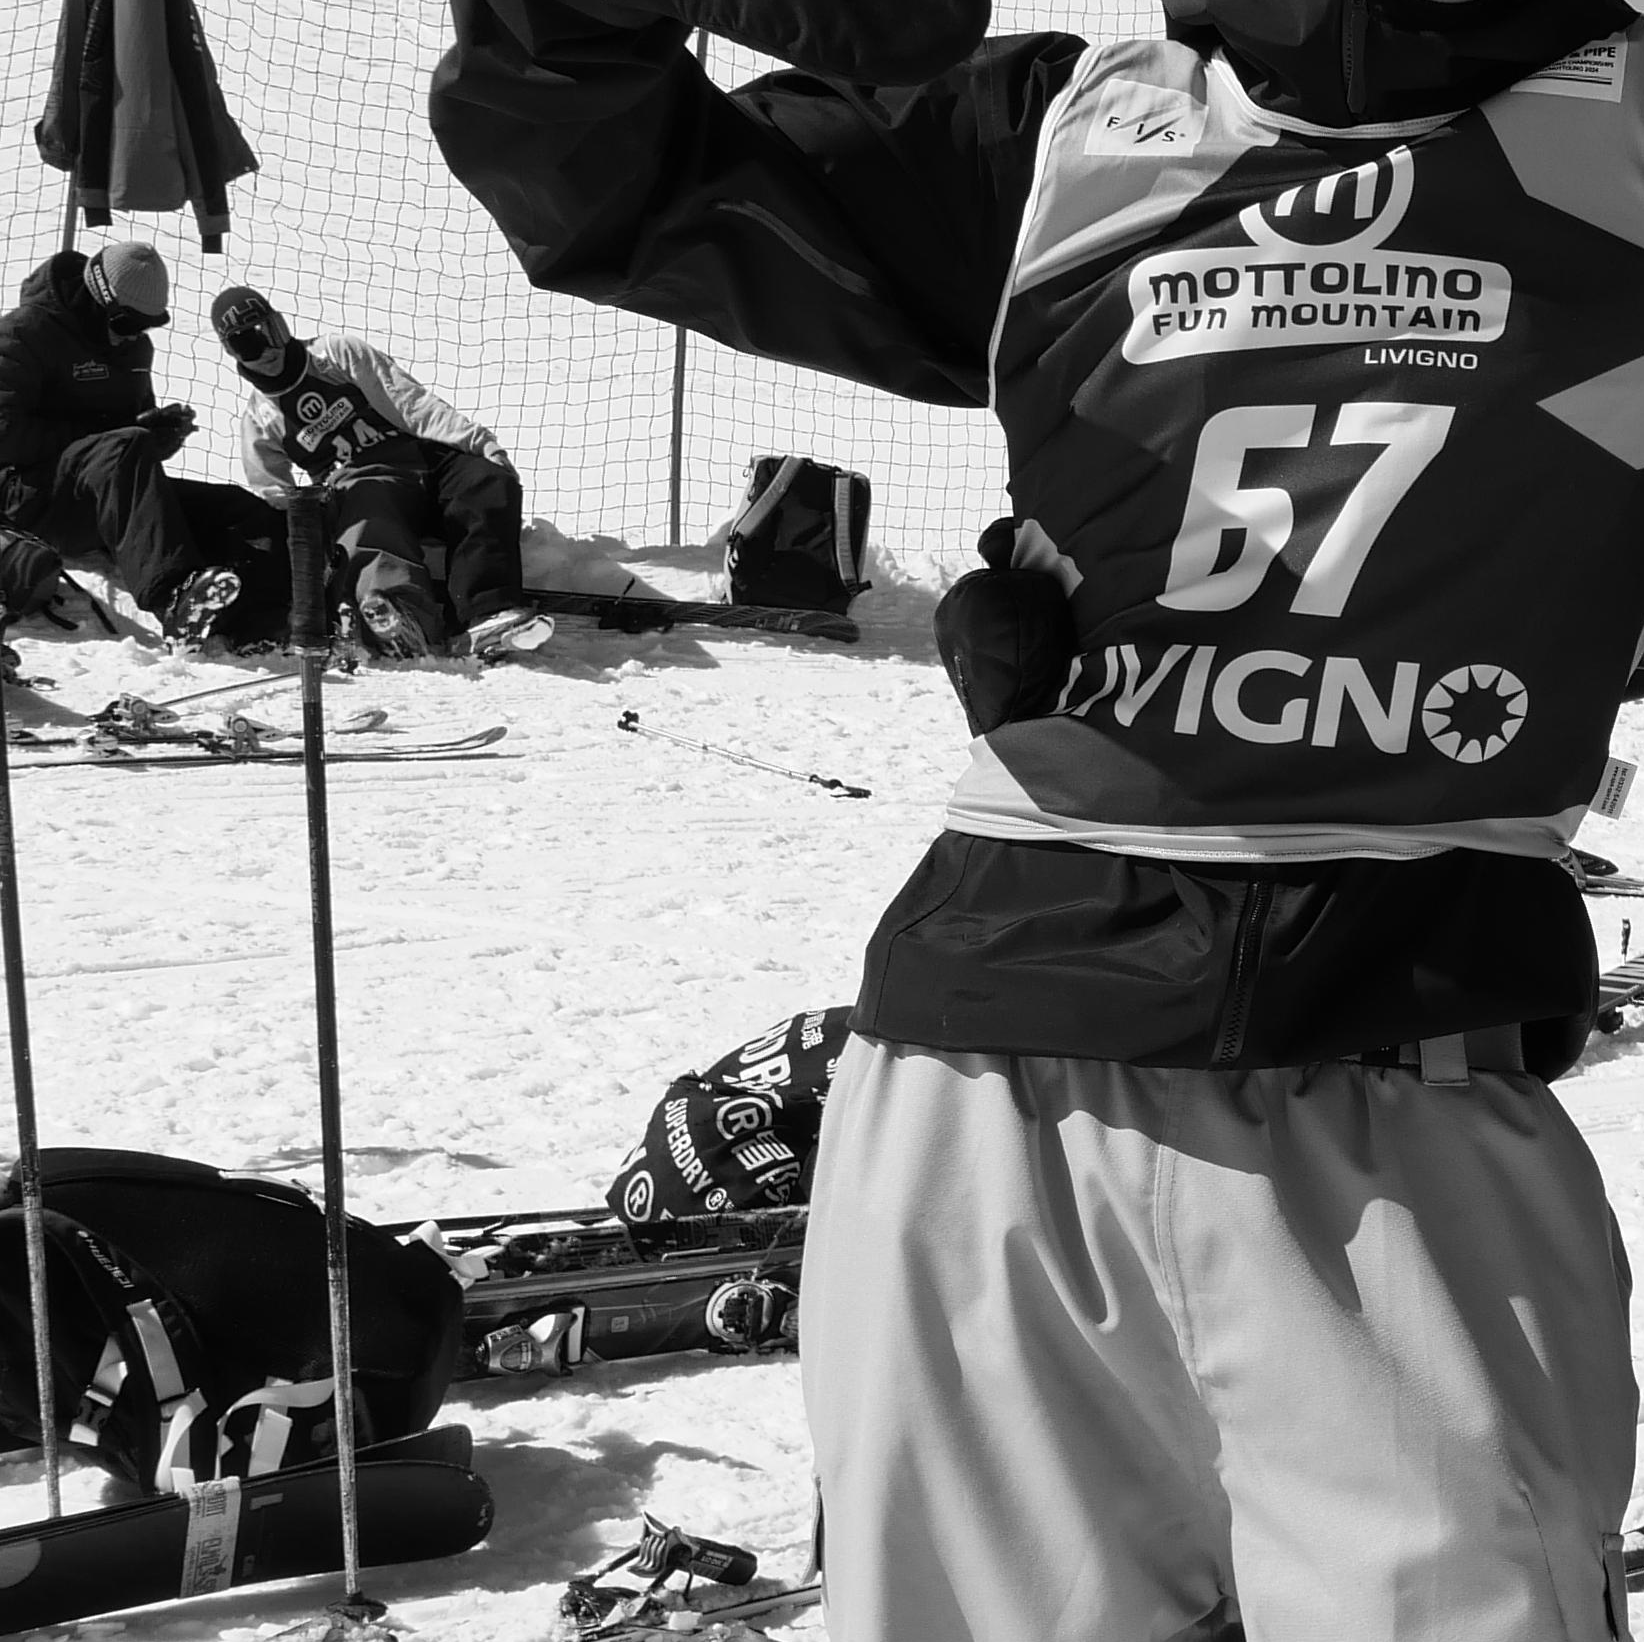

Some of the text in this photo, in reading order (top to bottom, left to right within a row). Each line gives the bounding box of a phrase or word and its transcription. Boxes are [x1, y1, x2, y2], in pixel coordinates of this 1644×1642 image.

[1583, 46, 1616, 58] PIPE
[1106, 116, 1176, 143] FIS
[1364, 348, 1479, 371] LIVIGNO
[1155, 401, 1458, 619] 67
[664, 1097, 714, 1193] SUPERDRY
